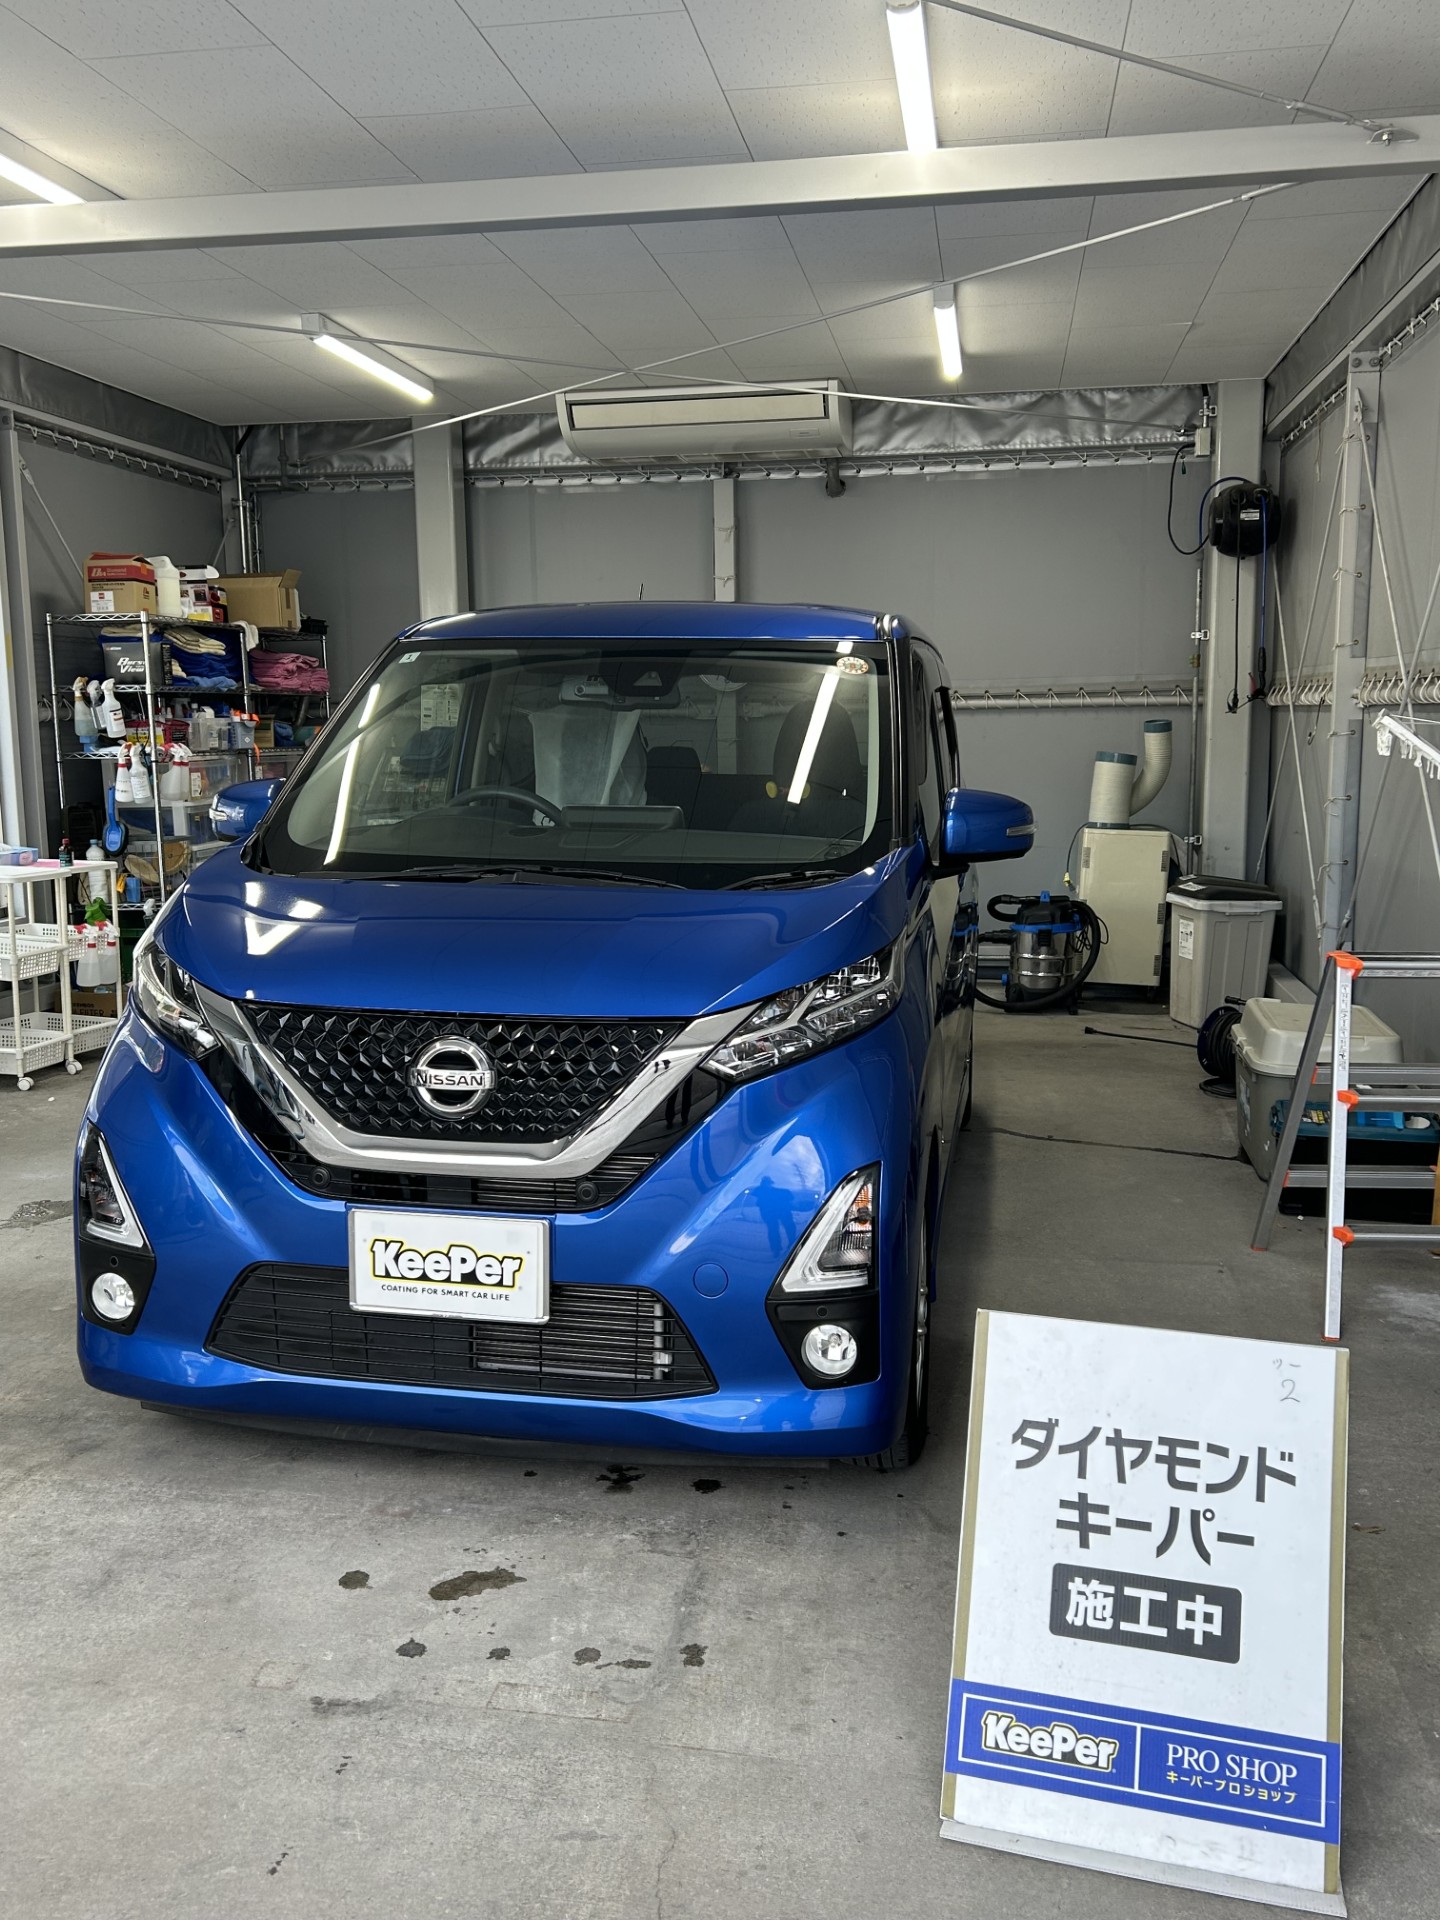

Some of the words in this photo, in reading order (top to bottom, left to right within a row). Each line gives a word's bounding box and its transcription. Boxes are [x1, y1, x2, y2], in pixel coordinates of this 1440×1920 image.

[416, 1072, 484, 1086] NISSAN
[371, 1239, 523, 1287] KeePer
[381, 1284, 419, 1294] COATING
[421, 1287, 439, 1296] FOR
[441, 1289, 469, 1298] SMART
[471, 1291, 488, 1300] CAR
[491, 1293, 511, 1302] LIFE
[1280, 1378, 1301, 1403] 2
[1010, 1418, 1298, 1503] ダイヤモンド
[1056, 1492, 1256, 1566] キーパー
[1065, 1577, 1225, 1647] 施工中
[982, 1711, 1119, 1772] KeePer
[1166, 1743, 1220, 1773] PRO
[1225, 1752, 1298, 1786] SHOP
[1166, 1771, 1298, 1805] キーパープロショップ
